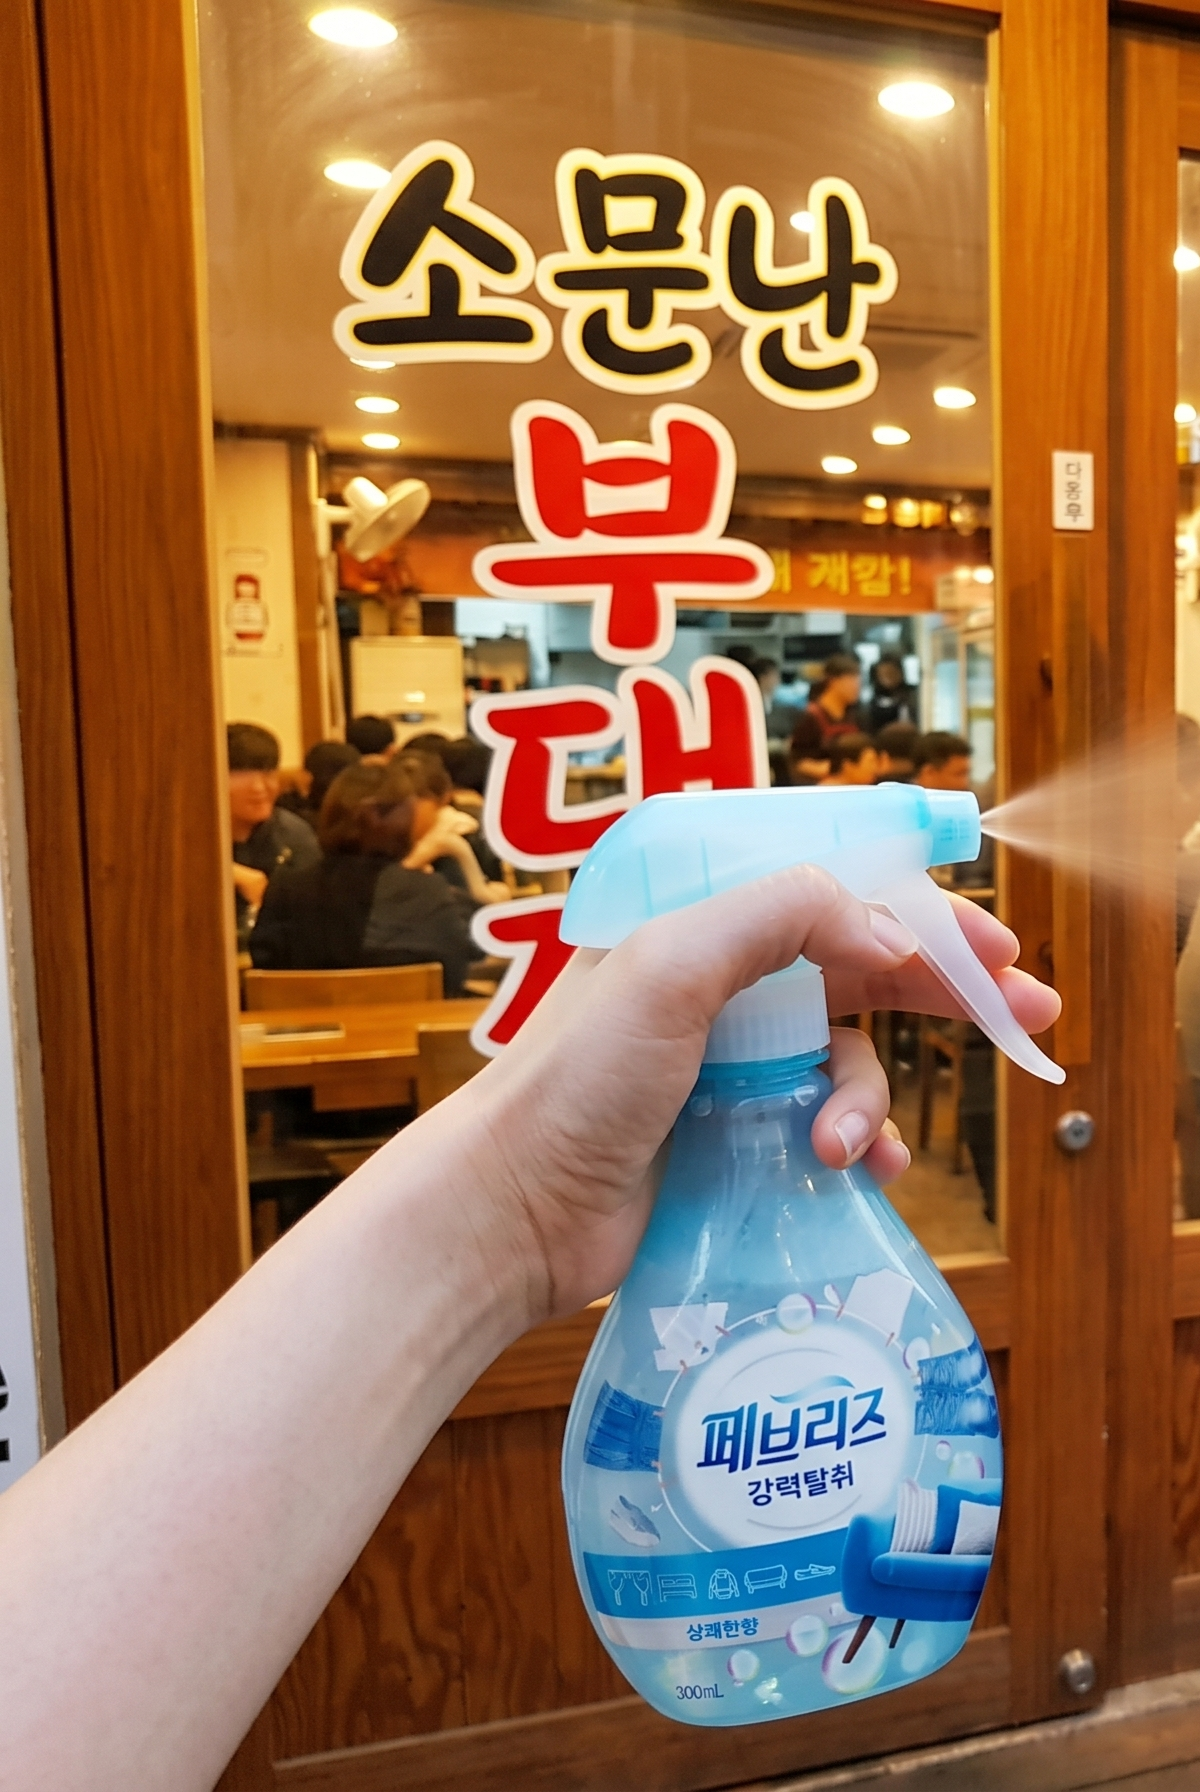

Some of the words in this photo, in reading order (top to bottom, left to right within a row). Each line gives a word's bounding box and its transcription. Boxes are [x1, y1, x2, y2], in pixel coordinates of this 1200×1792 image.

[343, 150, 889, 401] 소문난
[478, 408, 766, 1050] 부대
[696, 1386, 887, 1474] 페브리즈
[747, 1460, 854, 1507] 강력탈취
[686, 1616, 760, 1642] 상쾌한향
[675, 1683, 725, 1700] 300mL
